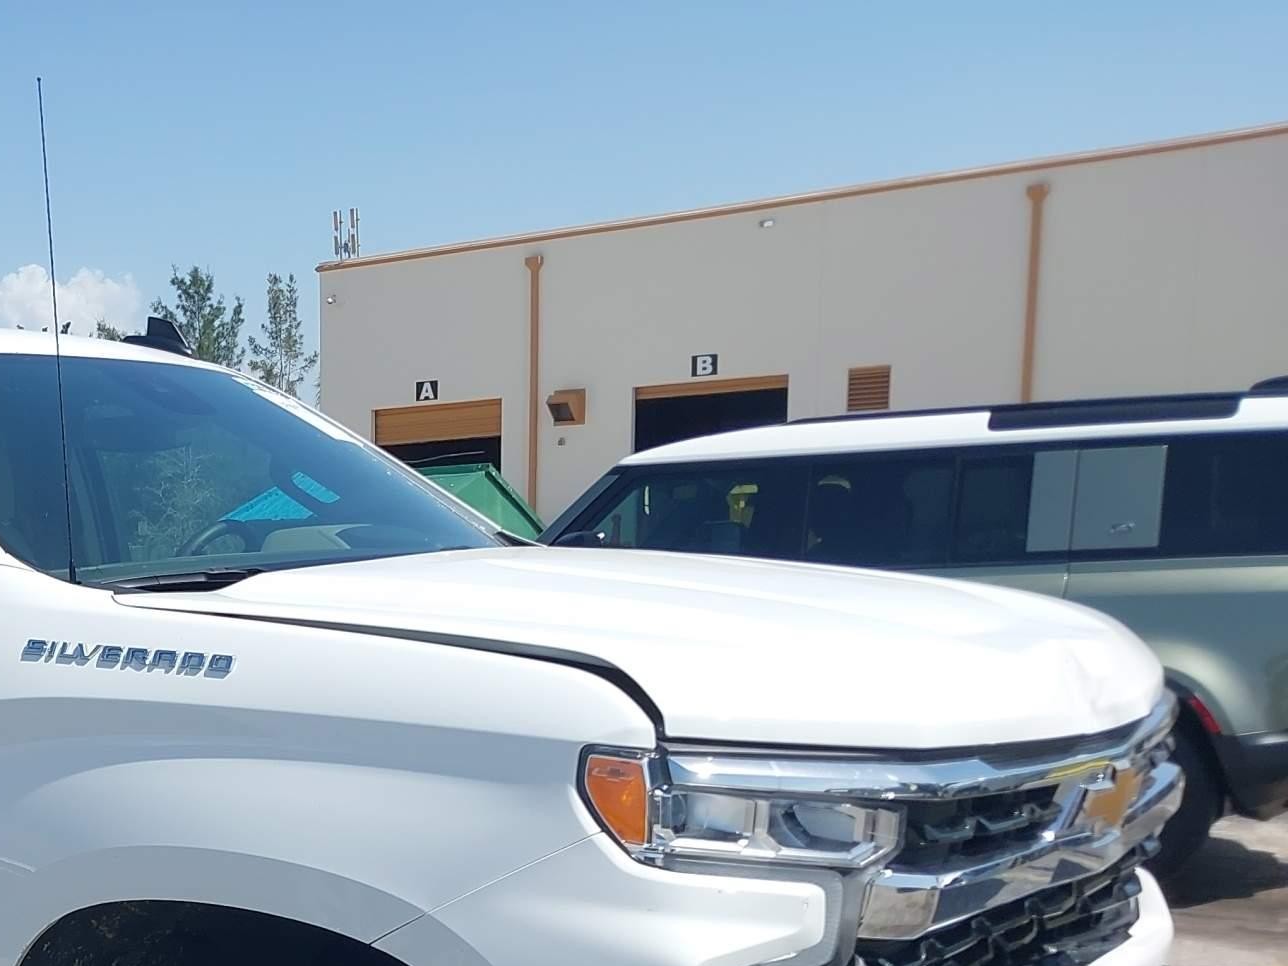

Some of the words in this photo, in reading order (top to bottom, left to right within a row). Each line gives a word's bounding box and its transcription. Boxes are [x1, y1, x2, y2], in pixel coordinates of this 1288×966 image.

[696, 355, 713, 376] B
[419, 381, 434, 400] A
[20, 639, 235, 679] SILVERADO
